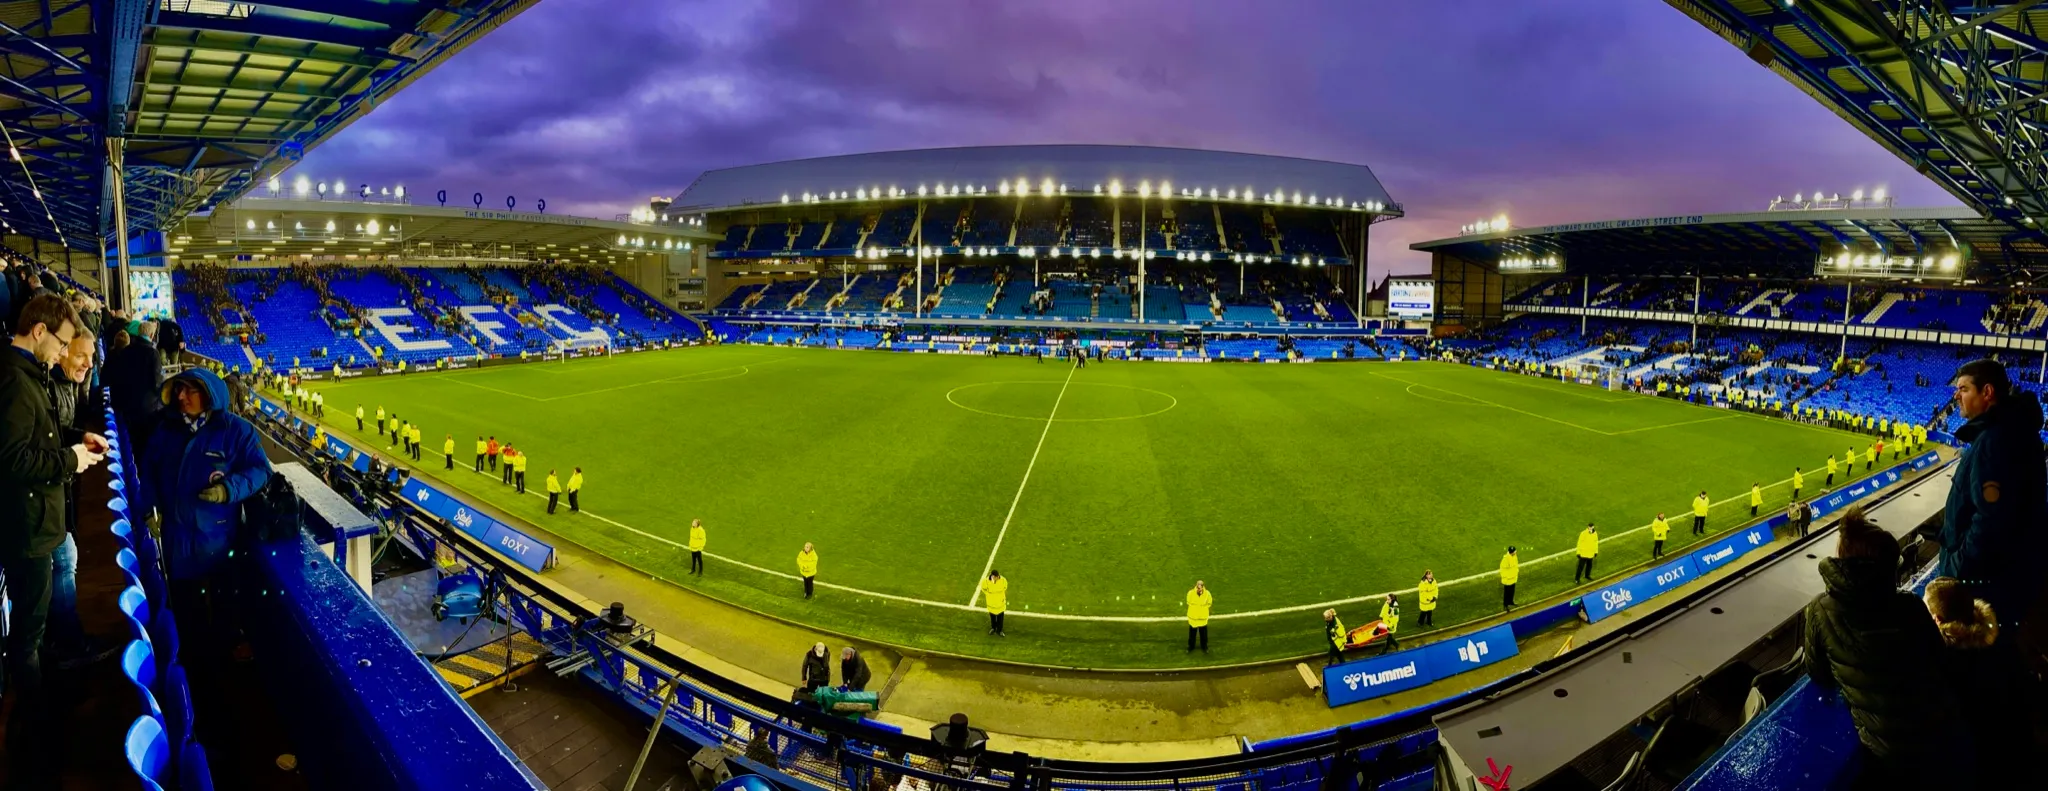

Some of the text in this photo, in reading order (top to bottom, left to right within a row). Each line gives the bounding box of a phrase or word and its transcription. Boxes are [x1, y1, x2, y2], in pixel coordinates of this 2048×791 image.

[1543, 215, 1703, 233] THE HOWARD KENDALL GWLADYS STREET END
[367, 304, 609, 350] EFC
[454, 508, 473, 528] Stake
[501, 535, 530, 556] BOXT
[1602, 587, 1633, 611] Stake
[1656, 565, 1686, 586] BOXT
[1362, 661, 1417, 687] hummel
